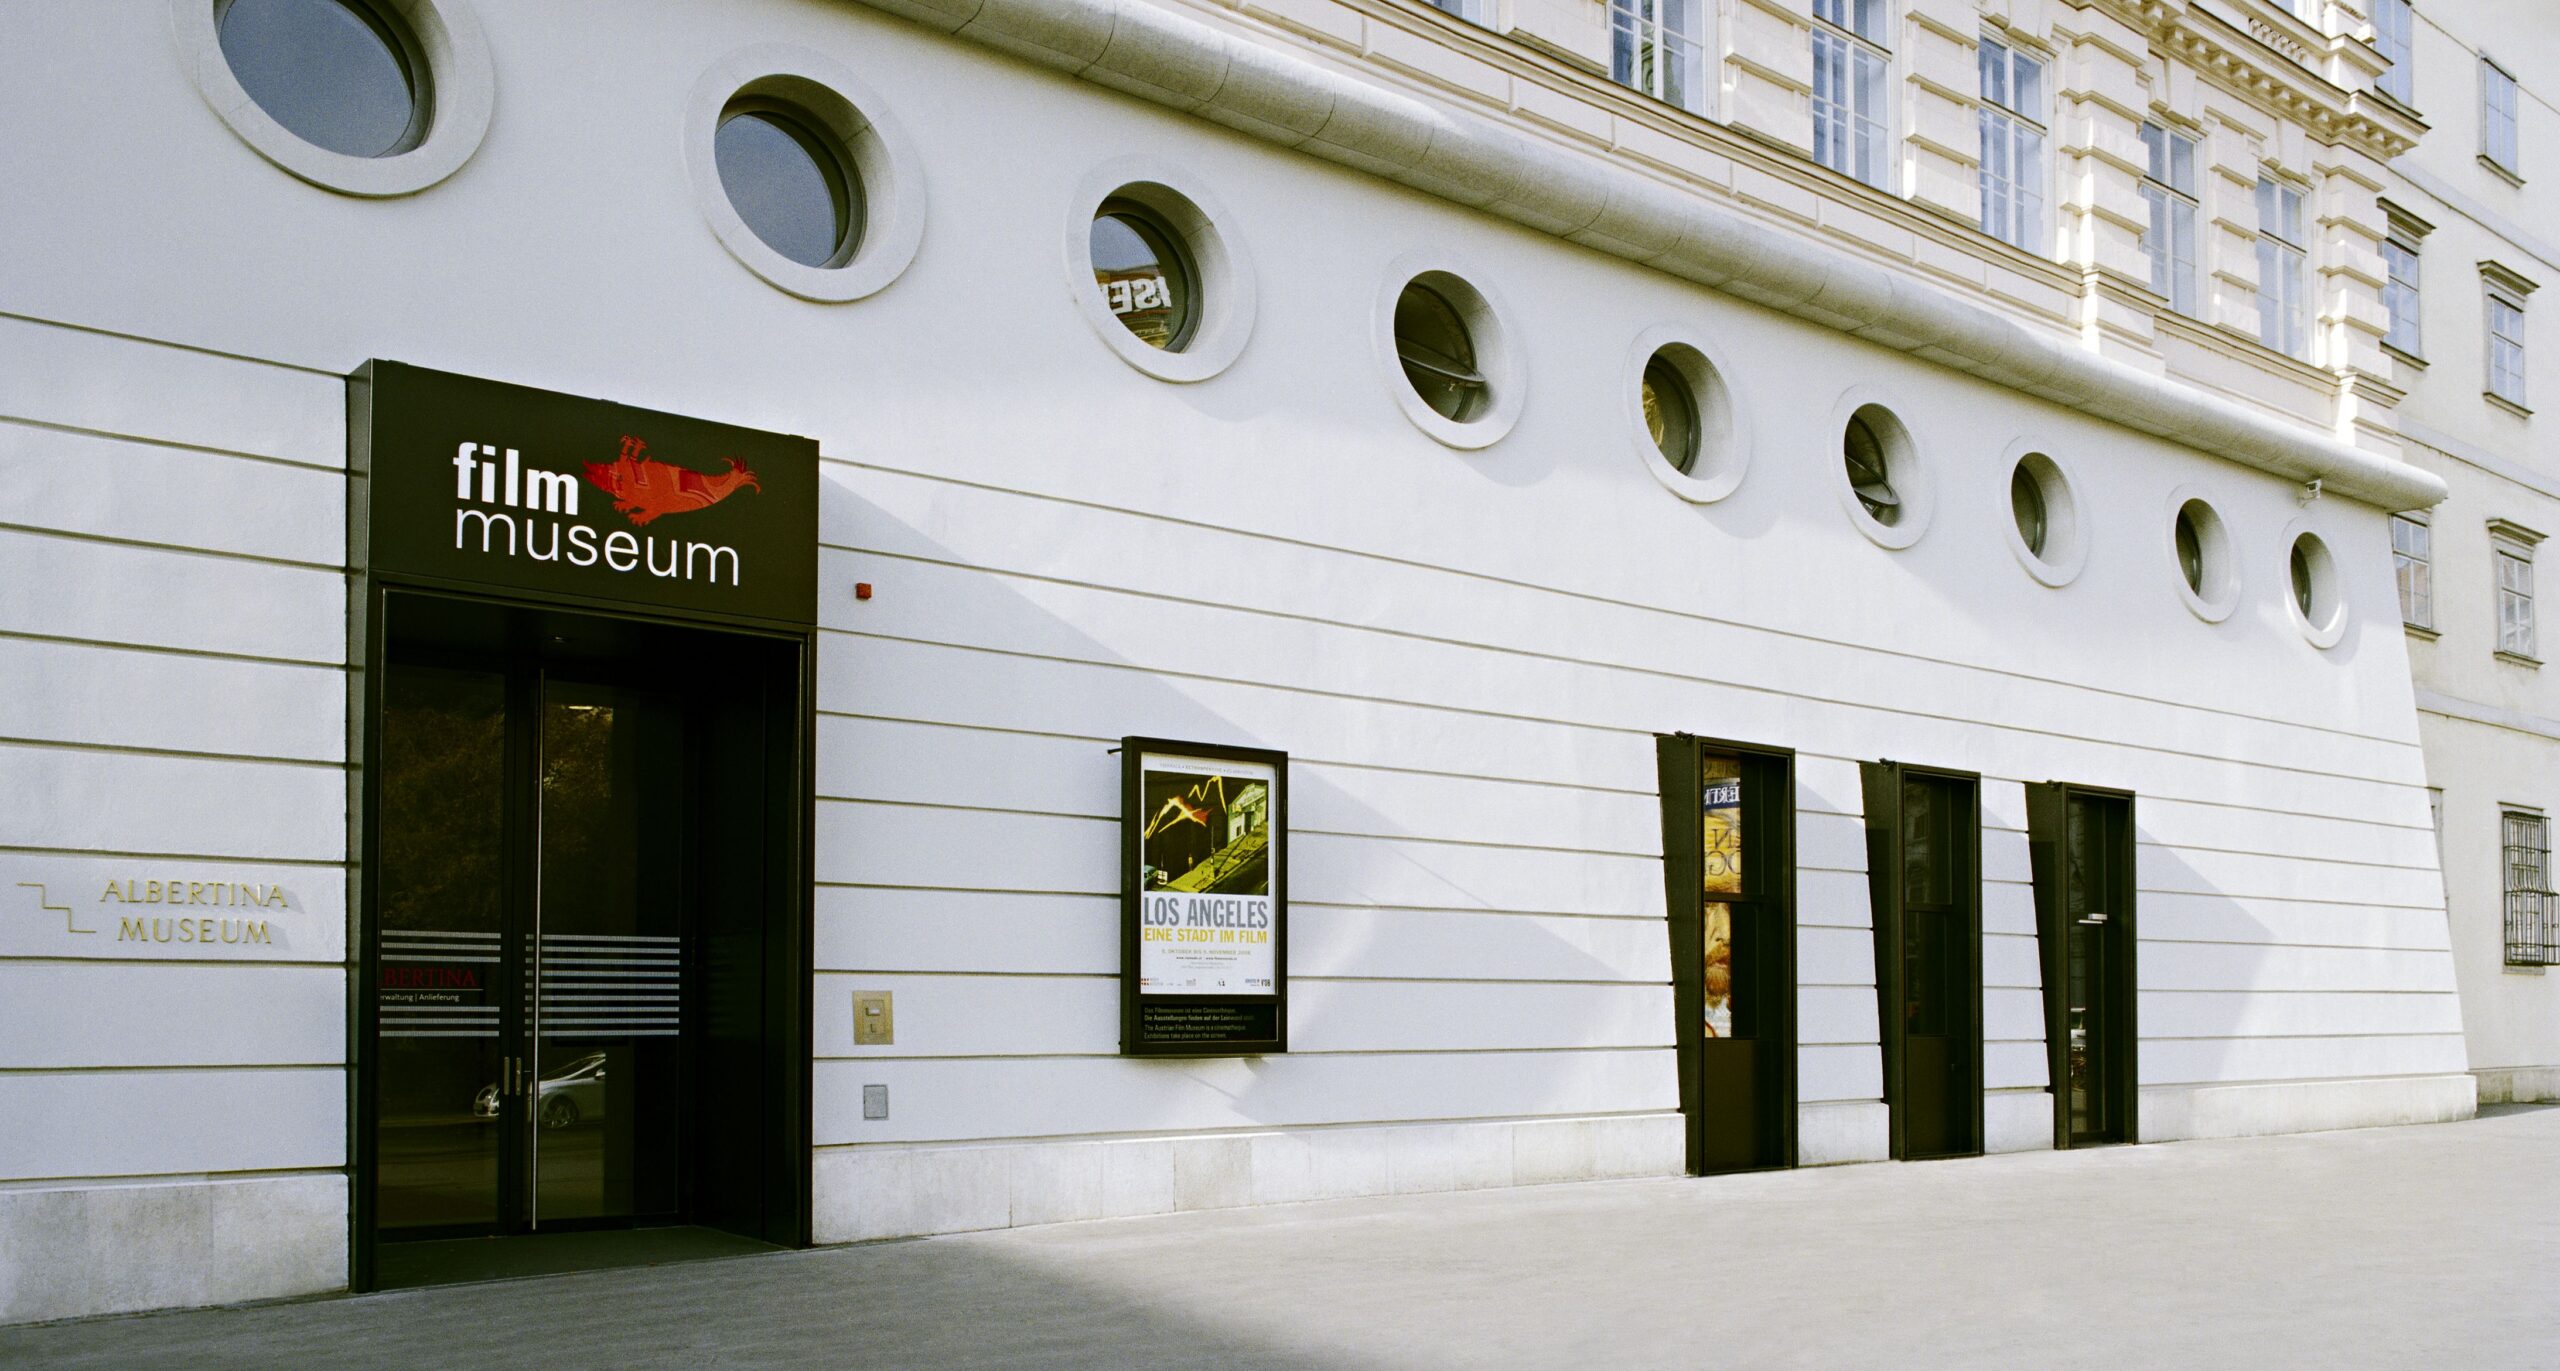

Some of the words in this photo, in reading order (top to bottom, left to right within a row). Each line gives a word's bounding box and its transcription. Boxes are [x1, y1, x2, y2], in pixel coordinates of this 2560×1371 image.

[453, 441, 579, 515] film
[456, 508, 739, 586] museum
[100, 880, 287, 908] ALBERTINA
[1144, 896, 1180, 927] LOS
[1187, 898, 1269, 929] ANGELES
[117, 917, 272, 945] MUSEUM
[1144, 928, 1173, 942] EINE
[1177, 928, 1215, 943] STADT
[1219, 930, 1235, 943] IM
[1239, 930, 1268, 944] FILM
[418, 993, 460, 1003] Anlieferung
